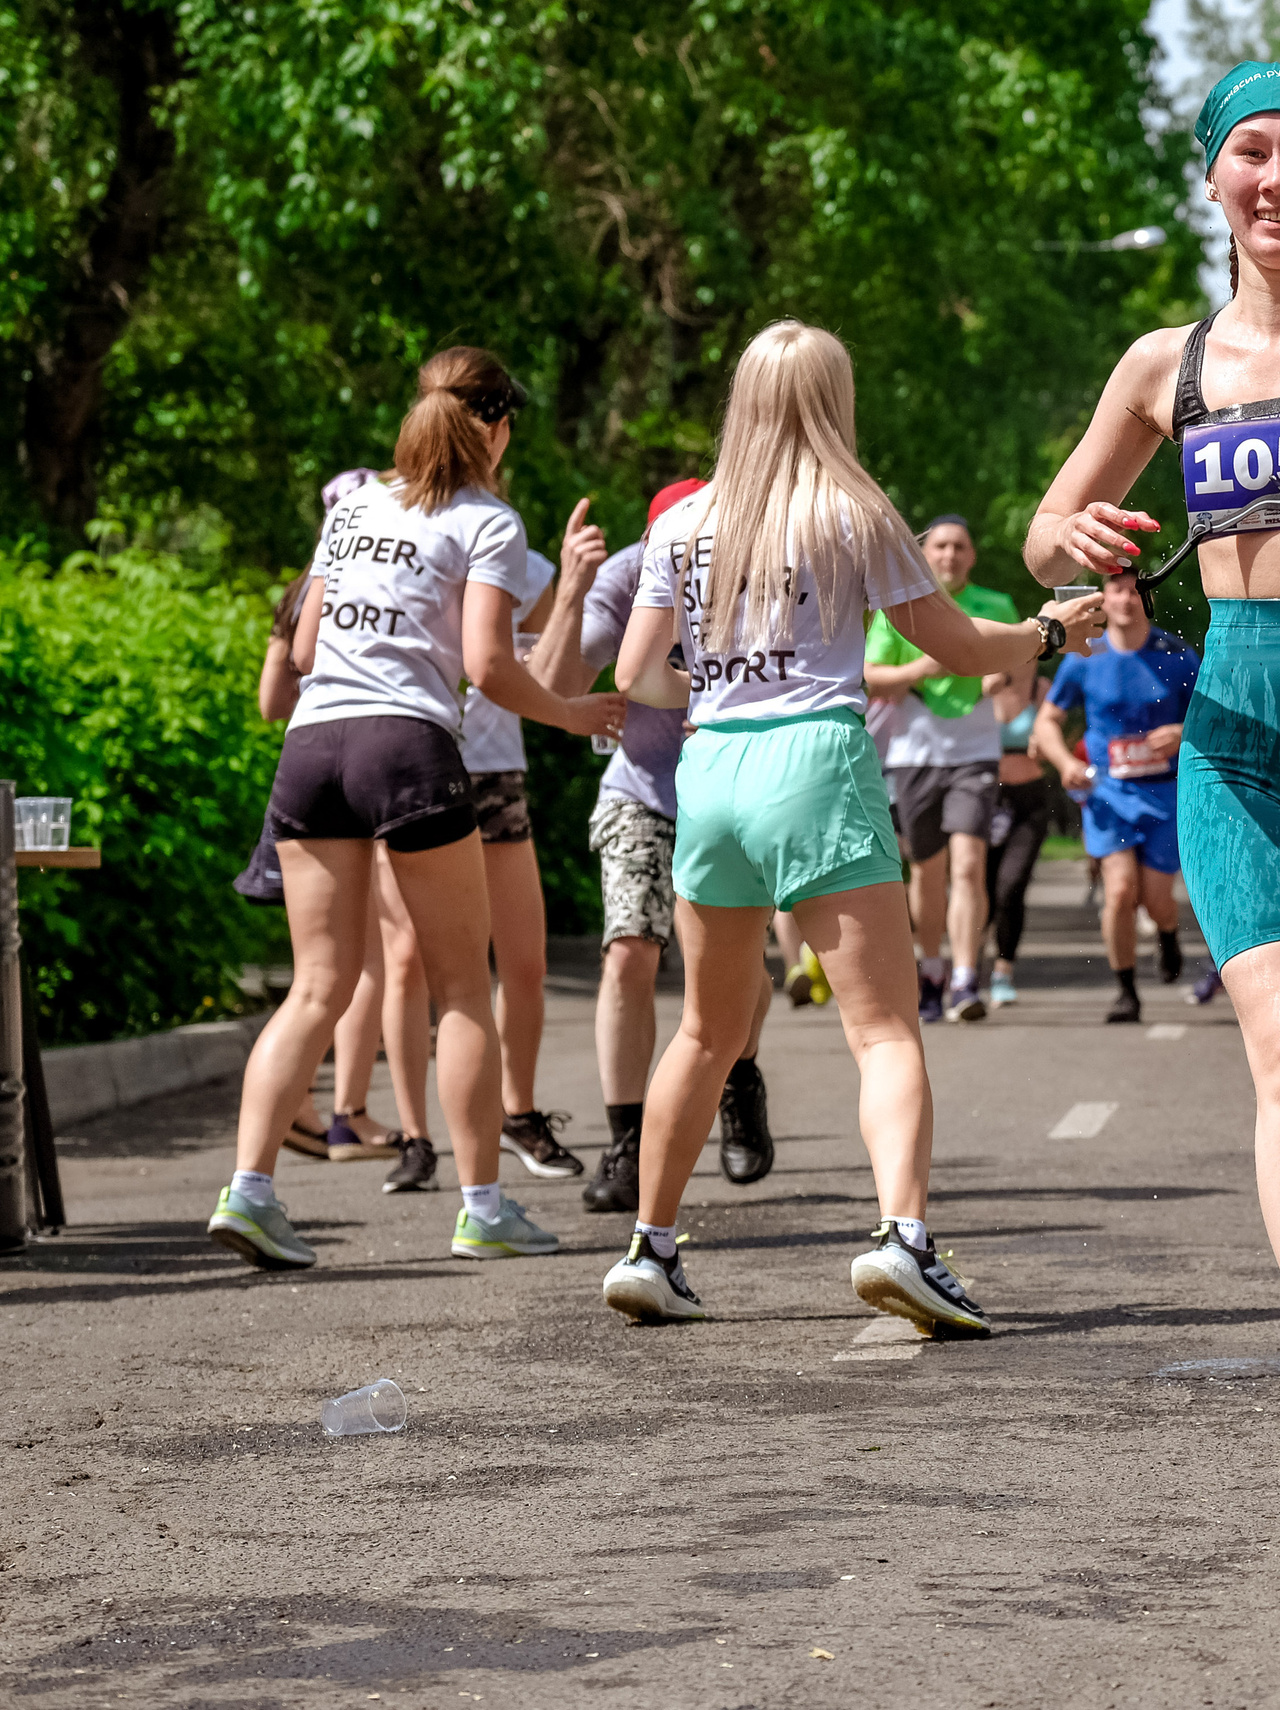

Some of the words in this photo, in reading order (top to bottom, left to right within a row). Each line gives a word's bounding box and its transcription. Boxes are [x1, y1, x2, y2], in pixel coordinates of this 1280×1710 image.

[331, 504, 369, 534] BE
[325, 535, 425, 576] SUPER,
[670, 535, 714, 574] BE
[324, 567, 344, 594] E
[320, 601, 406, 636] PORT
[690, 650, 795, 693] SPORT
